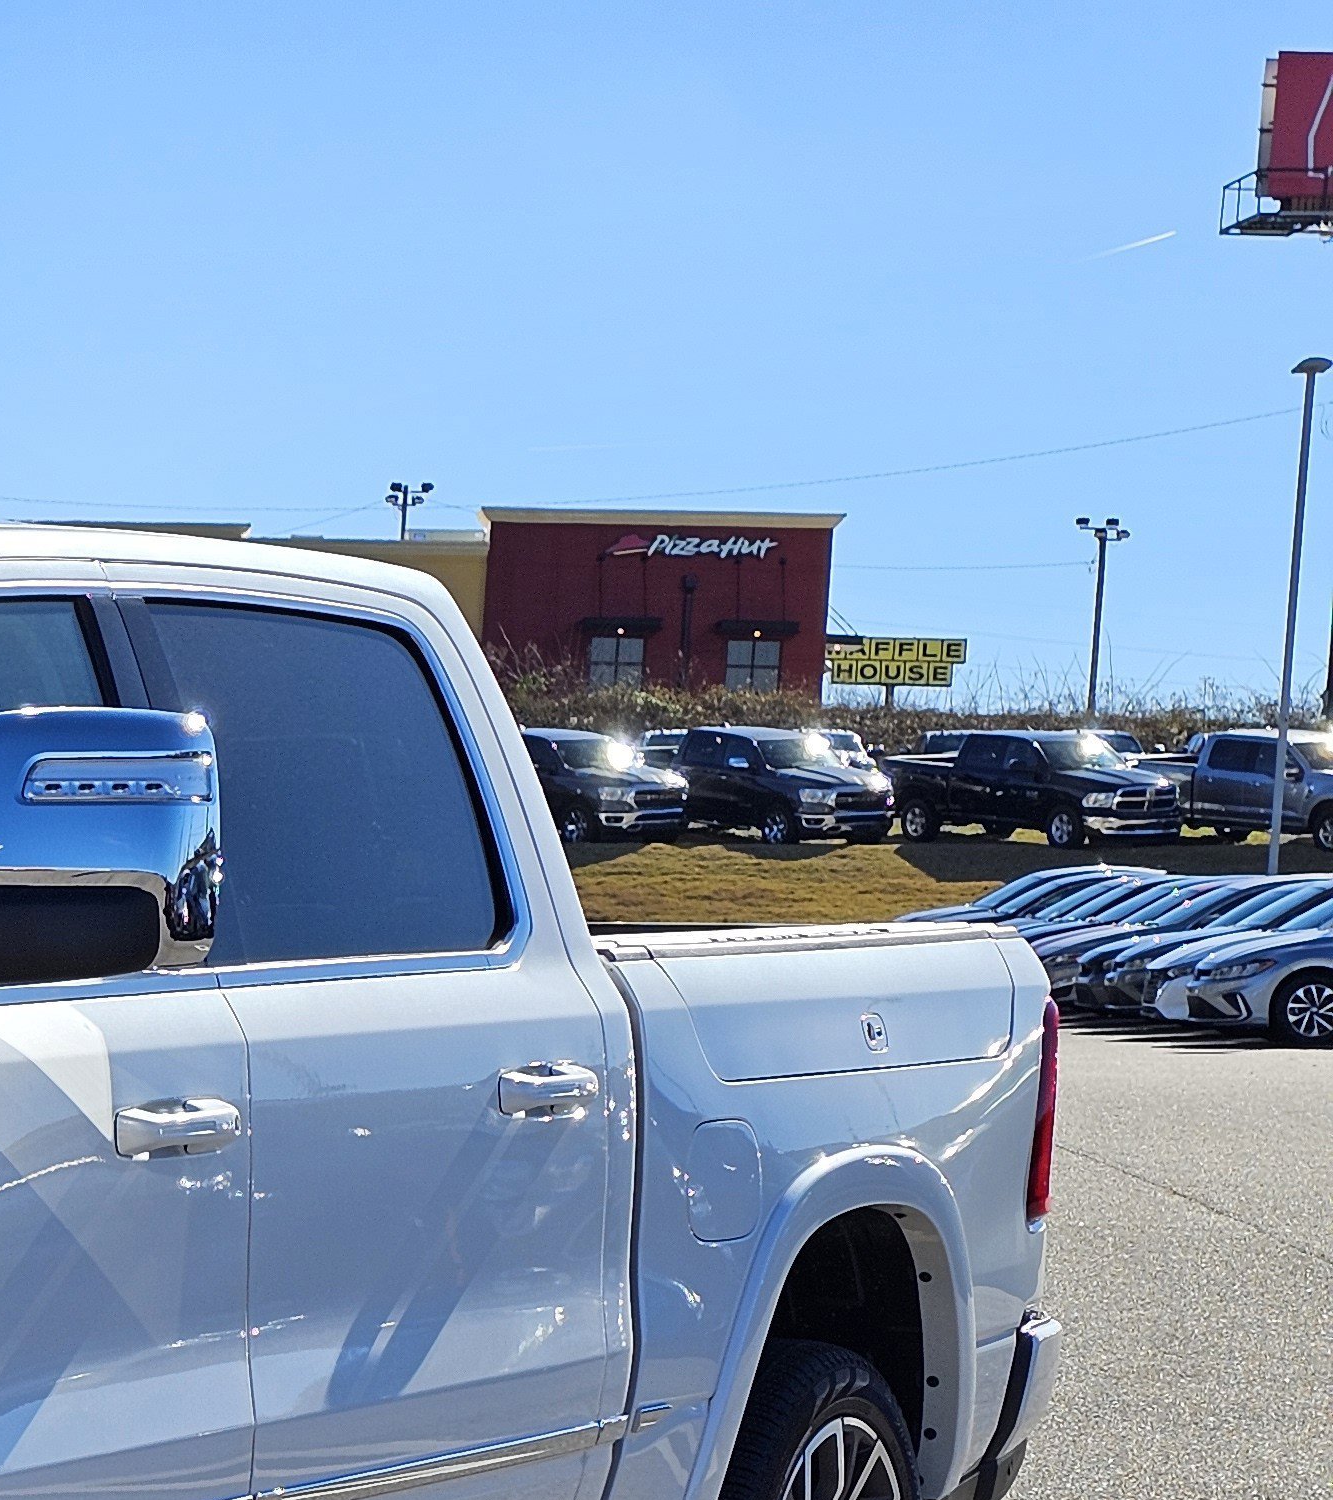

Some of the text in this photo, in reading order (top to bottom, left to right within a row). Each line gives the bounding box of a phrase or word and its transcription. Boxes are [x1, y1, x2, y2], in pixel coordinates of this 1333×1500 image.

[647, 534, 779, 559] Pizza Hut
[836, 662, 948, 682] HOUSE
